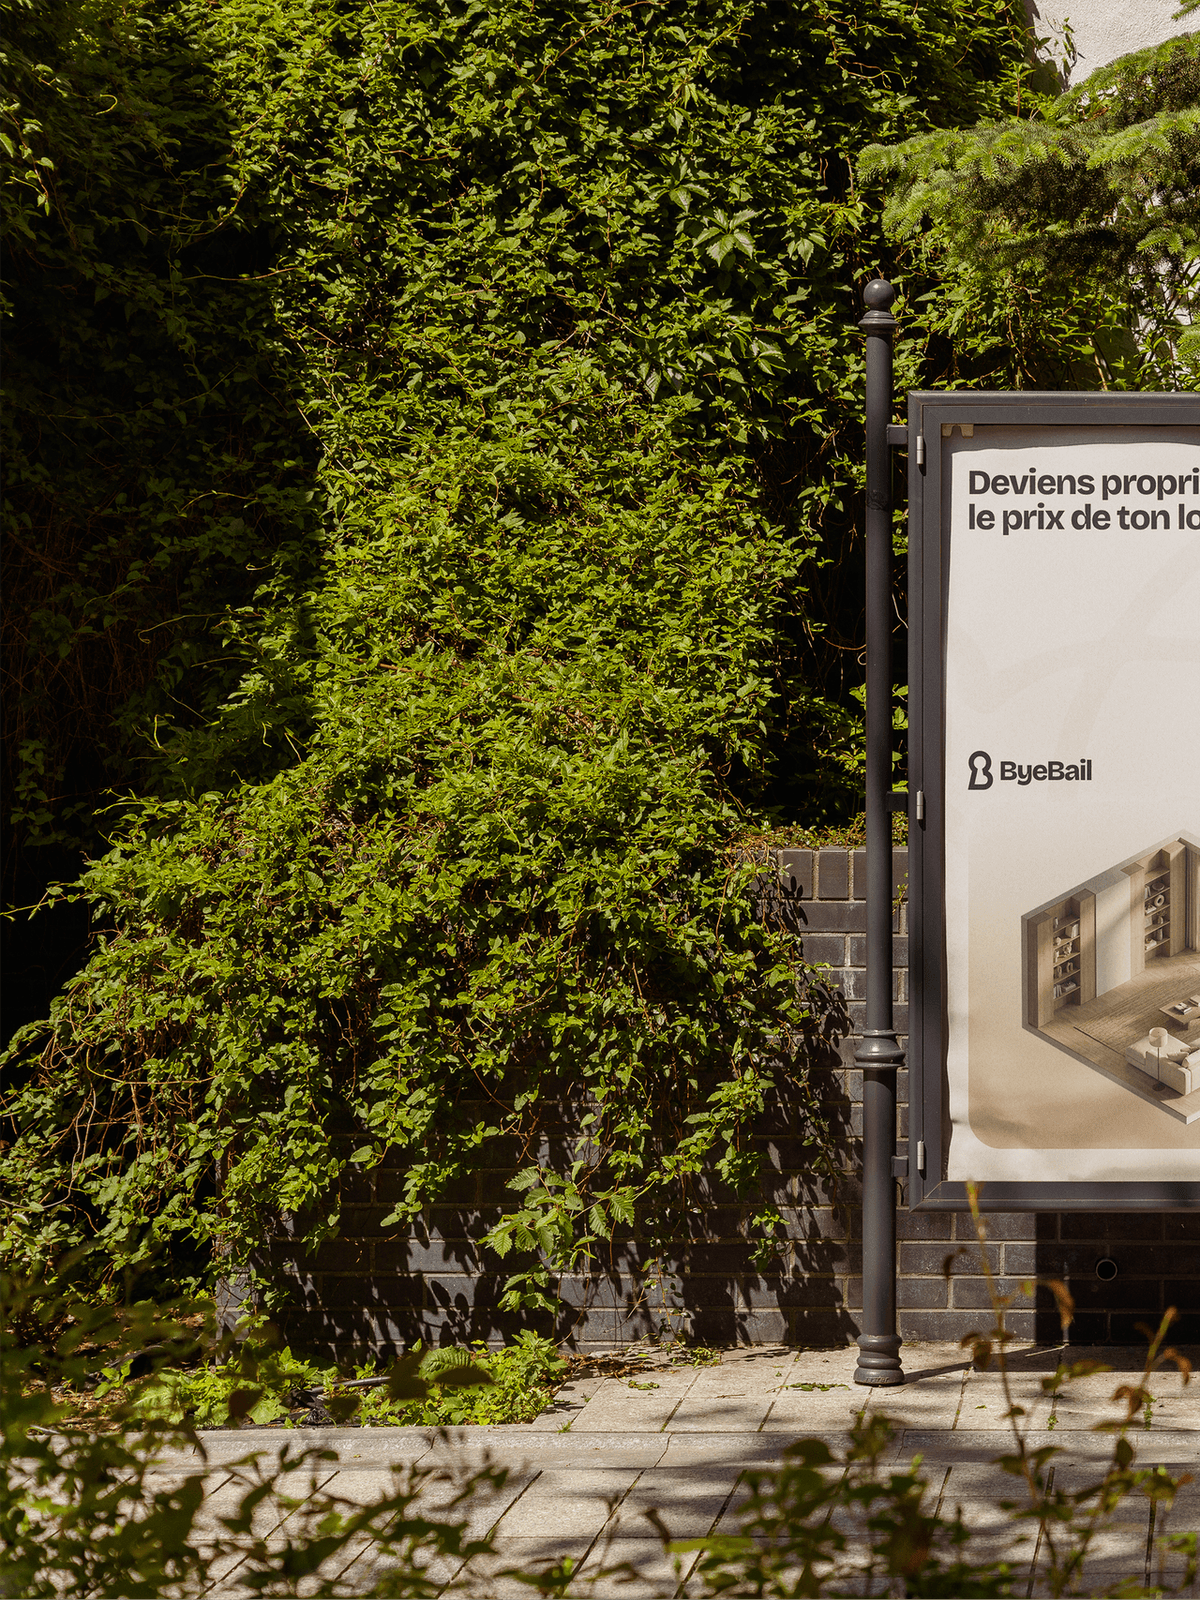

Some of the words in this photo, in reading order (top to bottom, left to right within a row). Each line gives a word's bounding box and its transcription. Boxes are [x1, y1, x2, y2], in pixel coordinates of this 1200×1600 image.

[968, 467, 1095, 496] Deviens
[968, 503, 996, 530] le
[1002, 502, 1065, 536] prix
[1070, 503, 1111, 530] de
[1116, 505, 1171, 530] ton
[1000, 758, 1093, 786] ByeBail
